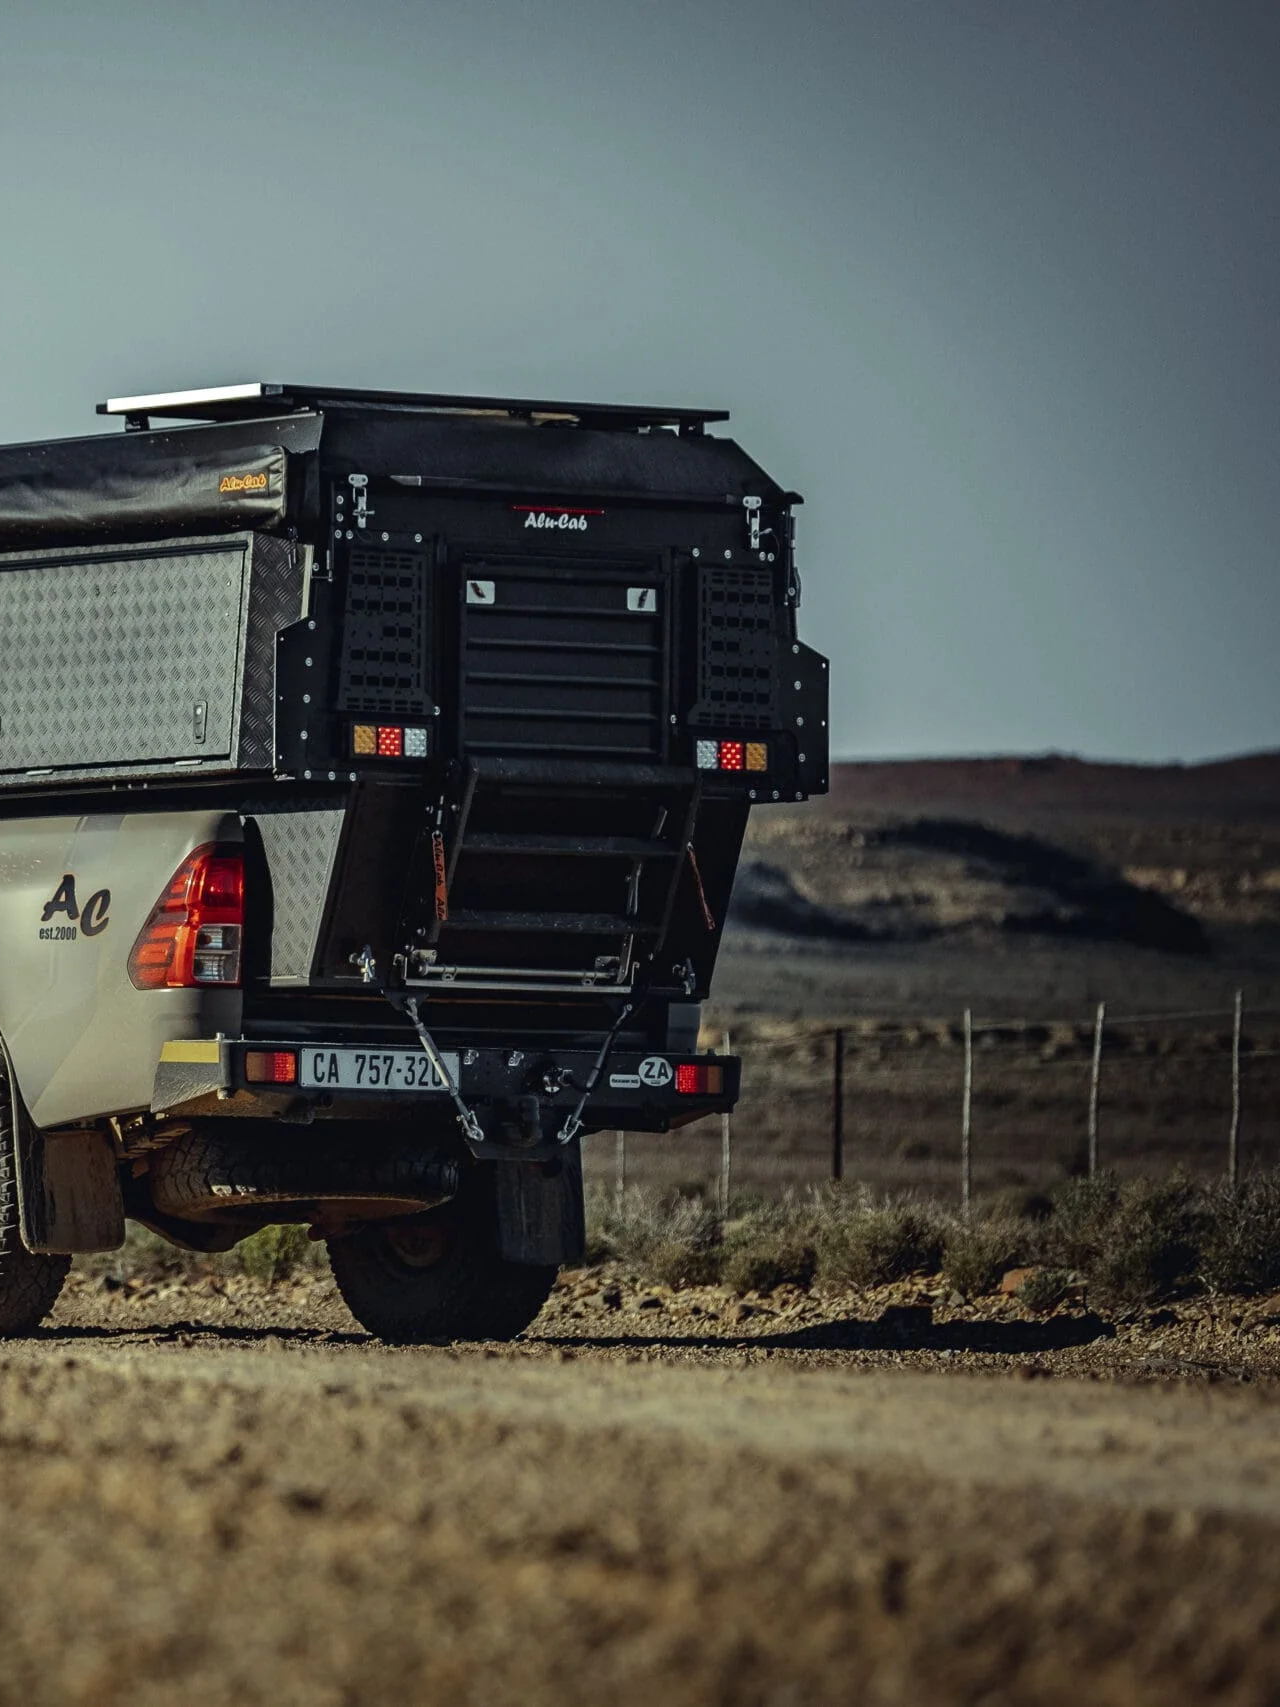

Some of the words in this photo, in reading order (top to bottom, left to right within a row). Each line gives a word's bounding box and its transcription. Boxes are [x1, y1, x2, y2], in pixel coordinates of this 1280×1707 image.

[524, 511, 588, 531] Alu-Cab
[313, 1053, 340, 1084] CA
[644, 1061, 670, 1079] ZA
